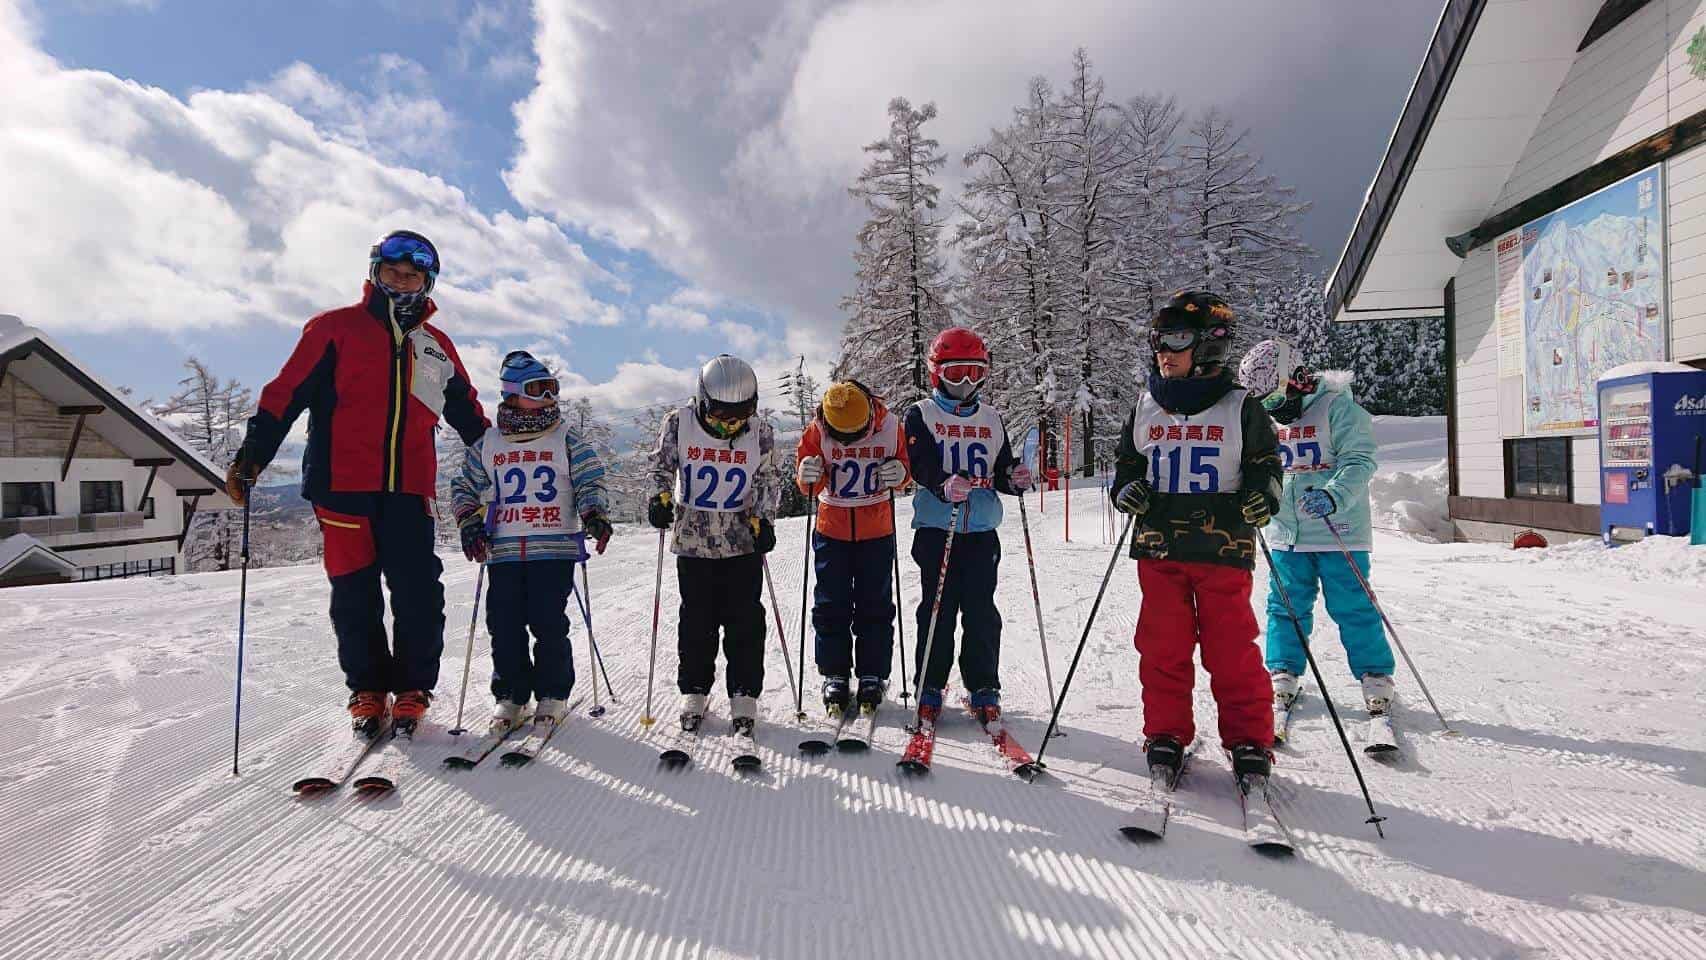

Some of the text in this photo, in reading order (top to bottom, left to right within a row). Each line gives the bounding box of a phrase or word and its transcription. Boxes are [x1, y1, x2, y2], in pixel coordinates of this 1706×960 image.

[1149, 424, 1224, 441] 妙高高原
[493, 451, 552, 466] 妙高高原
[688, 446, 747, 464] 妙高高原
[1152, 445, 1219, 493] 115
[494, 465, 557, 504] 123
[683, 464, 747, 509] 122
